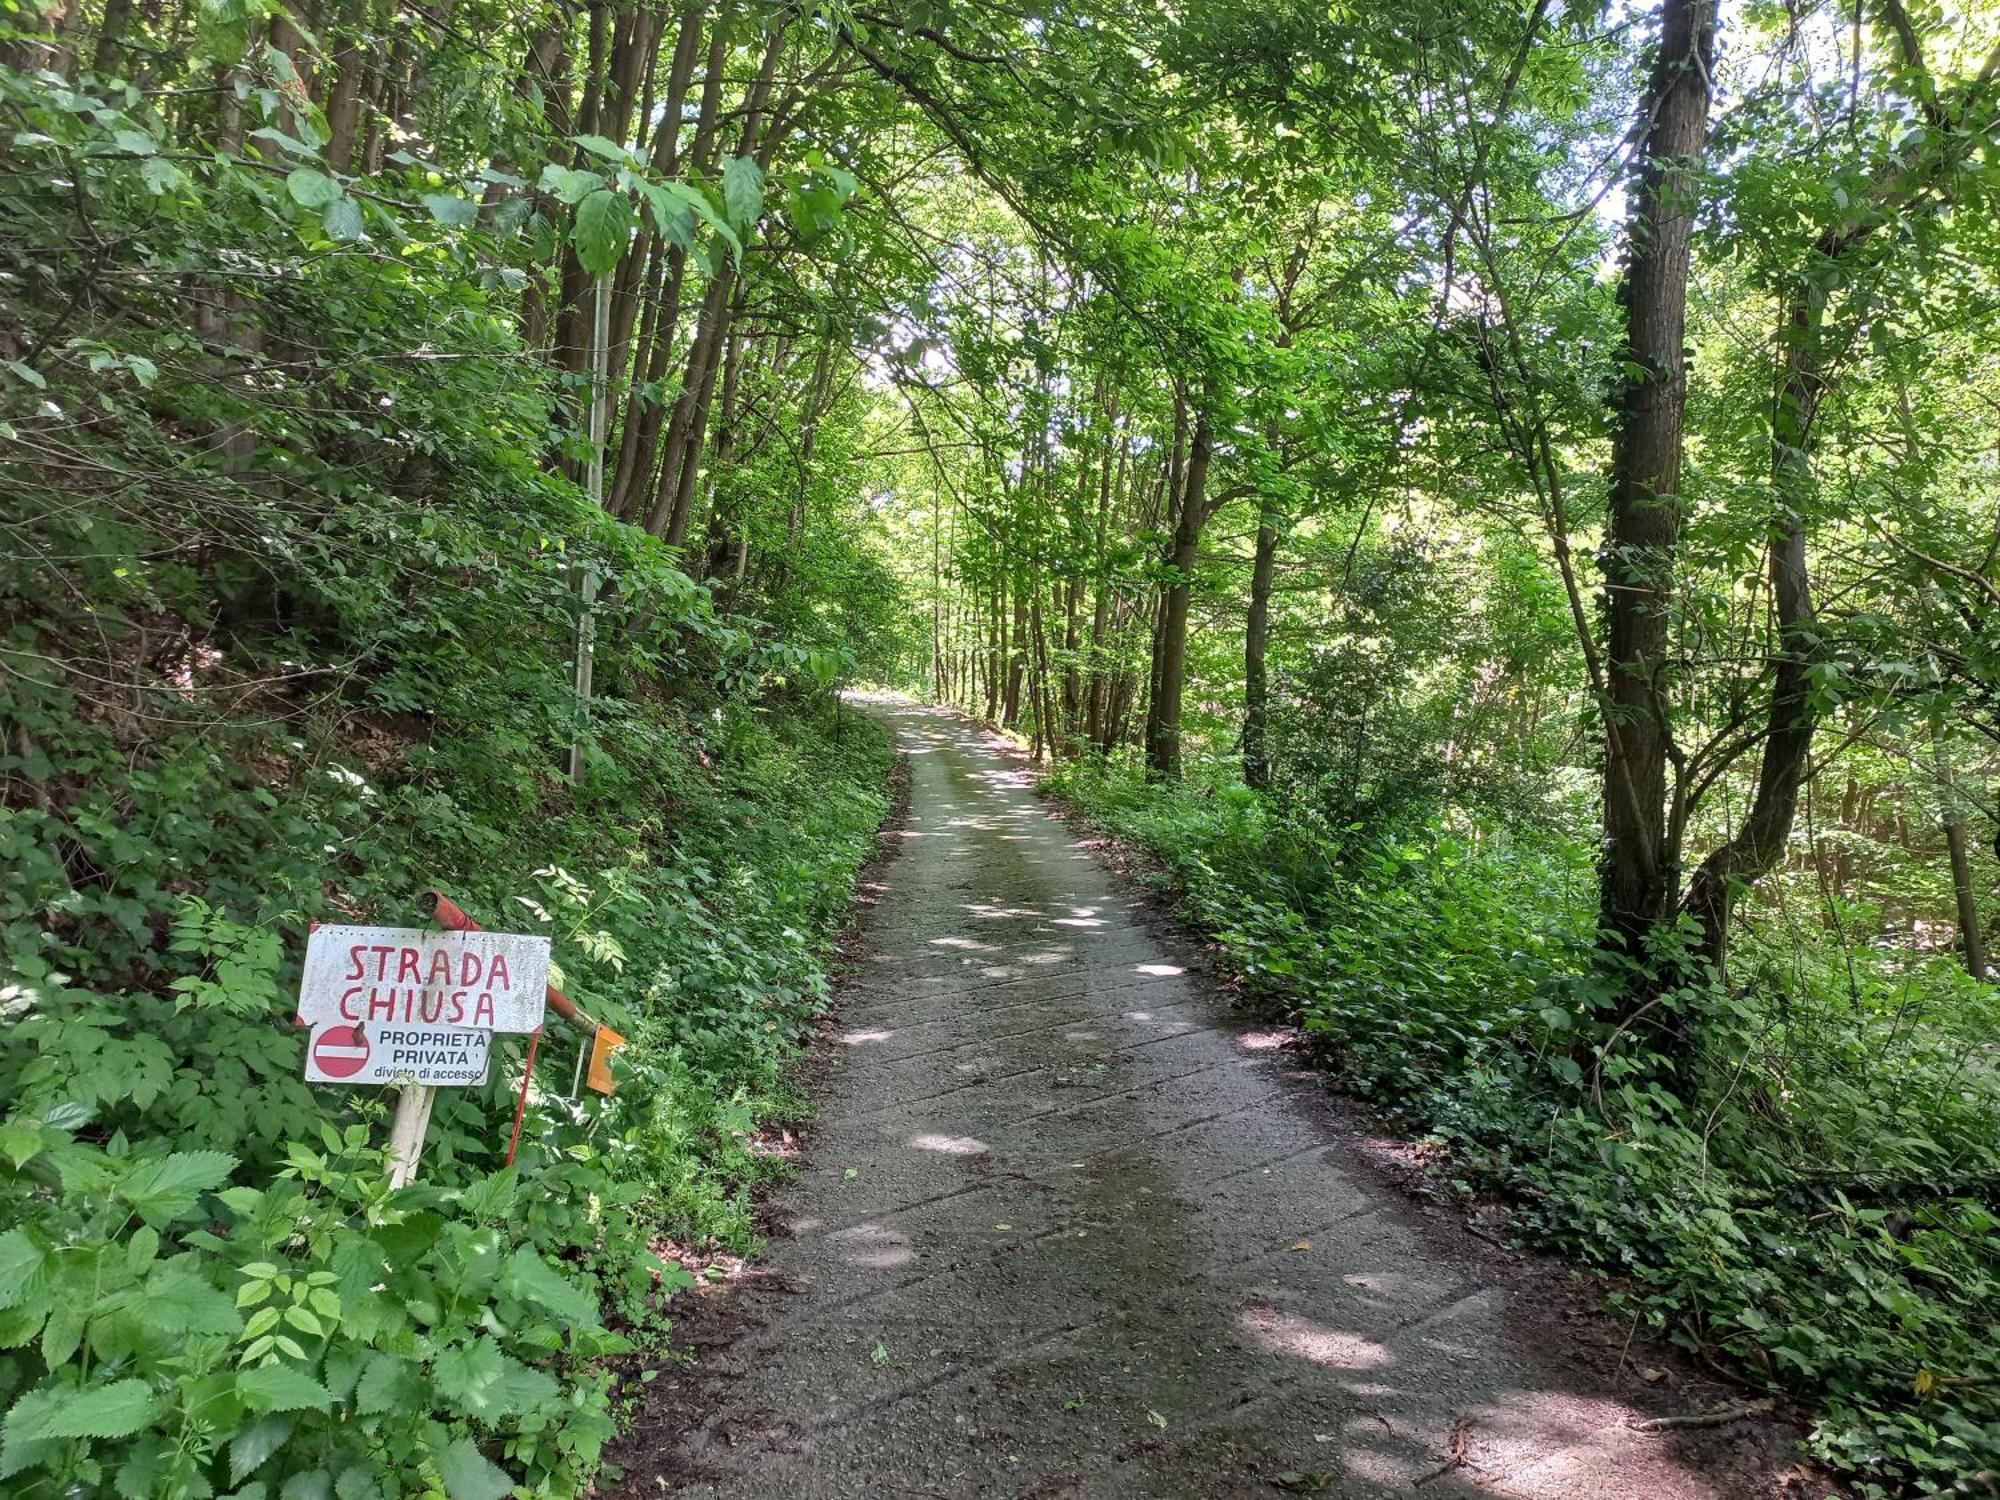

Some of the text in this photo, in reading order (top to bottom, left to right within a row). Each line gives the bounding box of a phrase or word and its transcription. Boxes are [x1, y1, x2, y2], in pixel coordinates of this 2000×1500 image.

[345, 945, 511, 991] STRADA
[340, 987, 495, 1026] CHIUSA
[393, 1049, 469, 1065] PRIVATA
[418, 1068, 431, 1079] di
[433, 1070, 482, 1080] accesso
